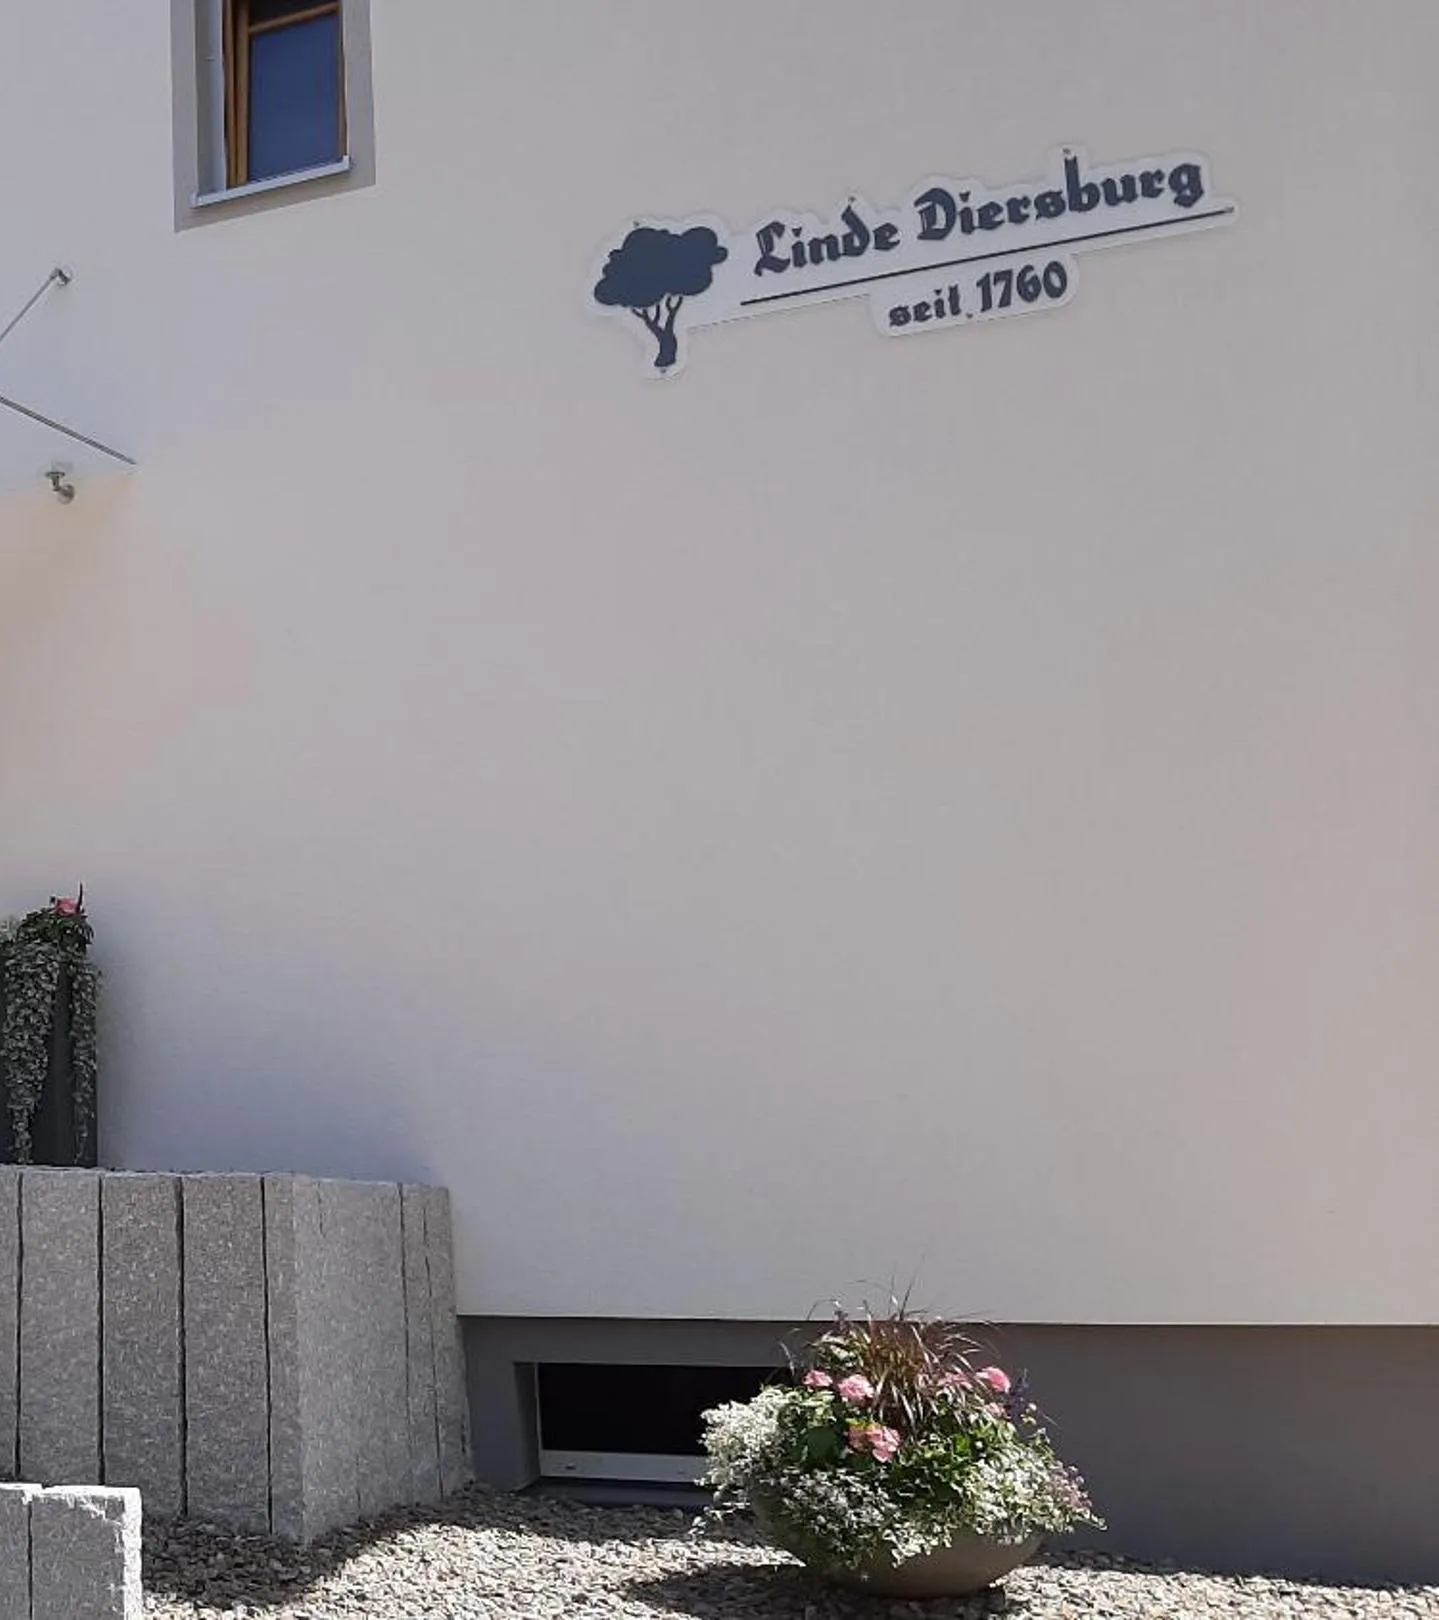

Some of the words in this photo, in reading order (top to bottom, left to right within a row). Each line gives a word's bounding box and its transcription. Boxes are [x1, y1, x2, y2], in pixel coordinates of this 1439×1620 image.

[753, 204, 901, 277] Linde
[913, 155, 1205, 241] Diersburg
[975, 260, 1068, 313] 1760
